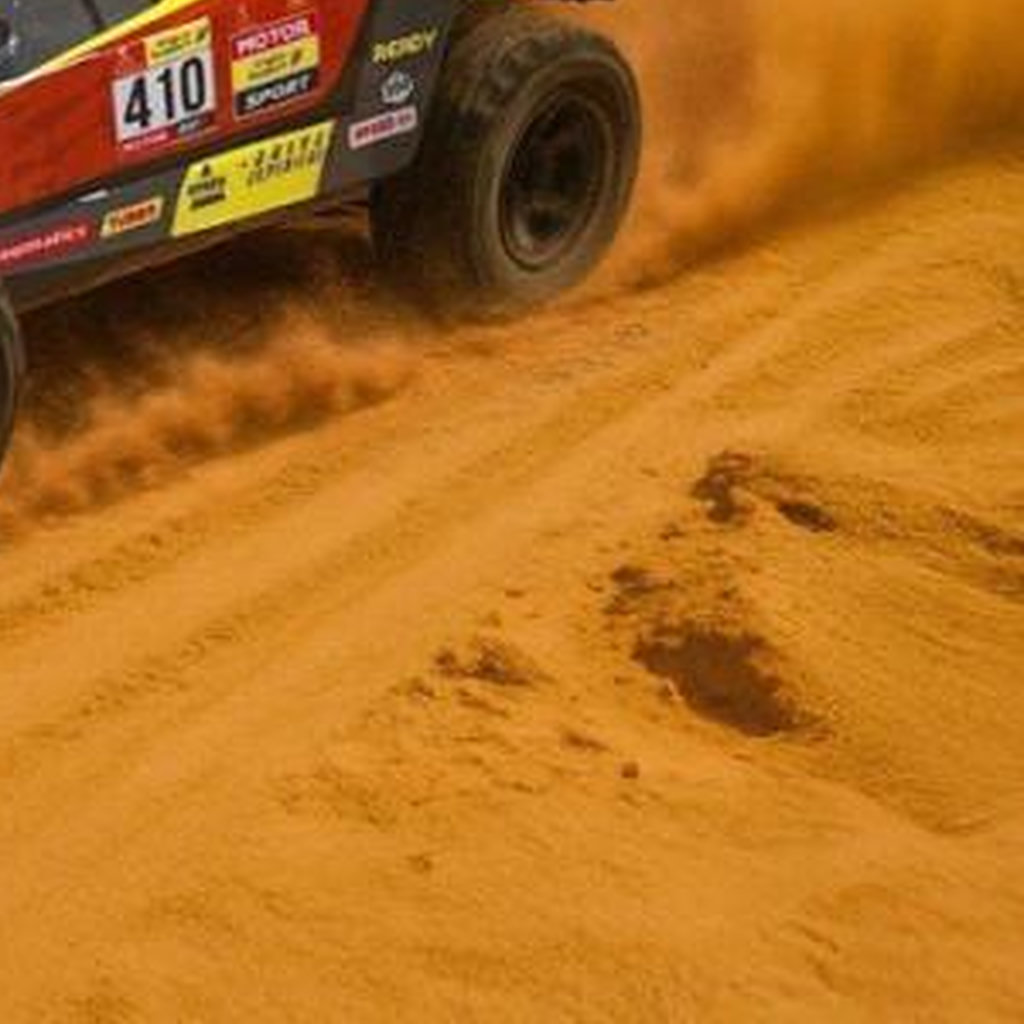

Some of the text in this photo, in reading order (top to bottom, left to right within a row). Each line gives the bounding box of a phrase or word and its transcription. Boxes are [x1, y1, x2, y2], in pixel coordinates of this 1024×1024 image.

[237, 18, 310, 55] MOTOR
[123, 56, 206, 128] 410
[245, 74, 311, 110] SPORT
